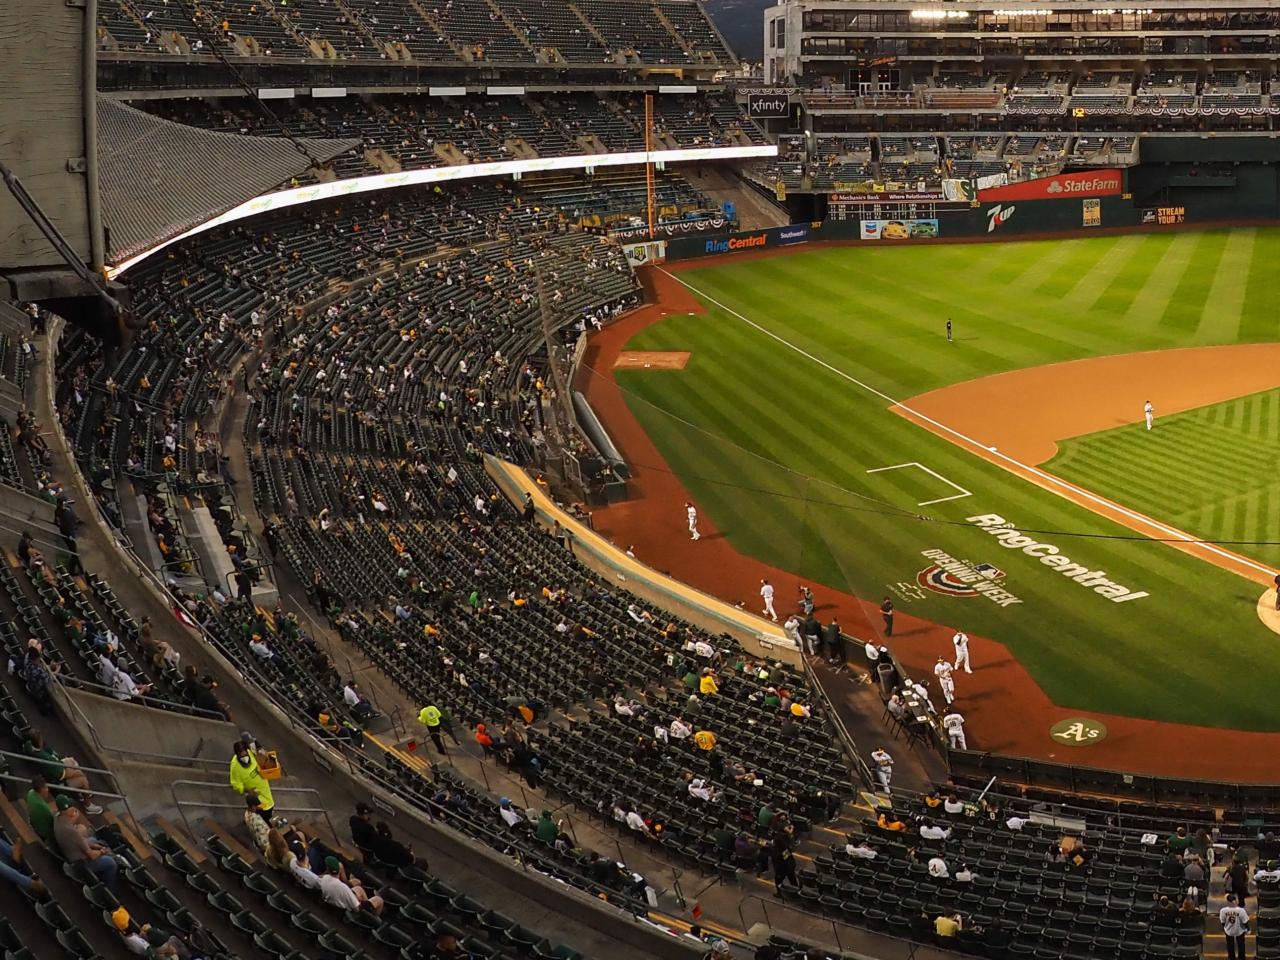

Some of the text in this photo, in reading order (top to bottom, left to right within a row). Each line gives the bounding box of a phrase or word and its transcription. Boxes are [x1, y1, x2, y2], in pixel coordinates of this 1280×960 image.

[752, 95, 786, 113] xfinity
[1158, 207, 1184, 216] STREAM
[1158, 215, 1175, 224] YOUR
[705, 234, 767, 252] RingCentral
[966, 513, 1149, 603] RingCentral
[921, 548, 1023, 607] OPENING WEEK
[1054, 722, 1099, 741] A's
